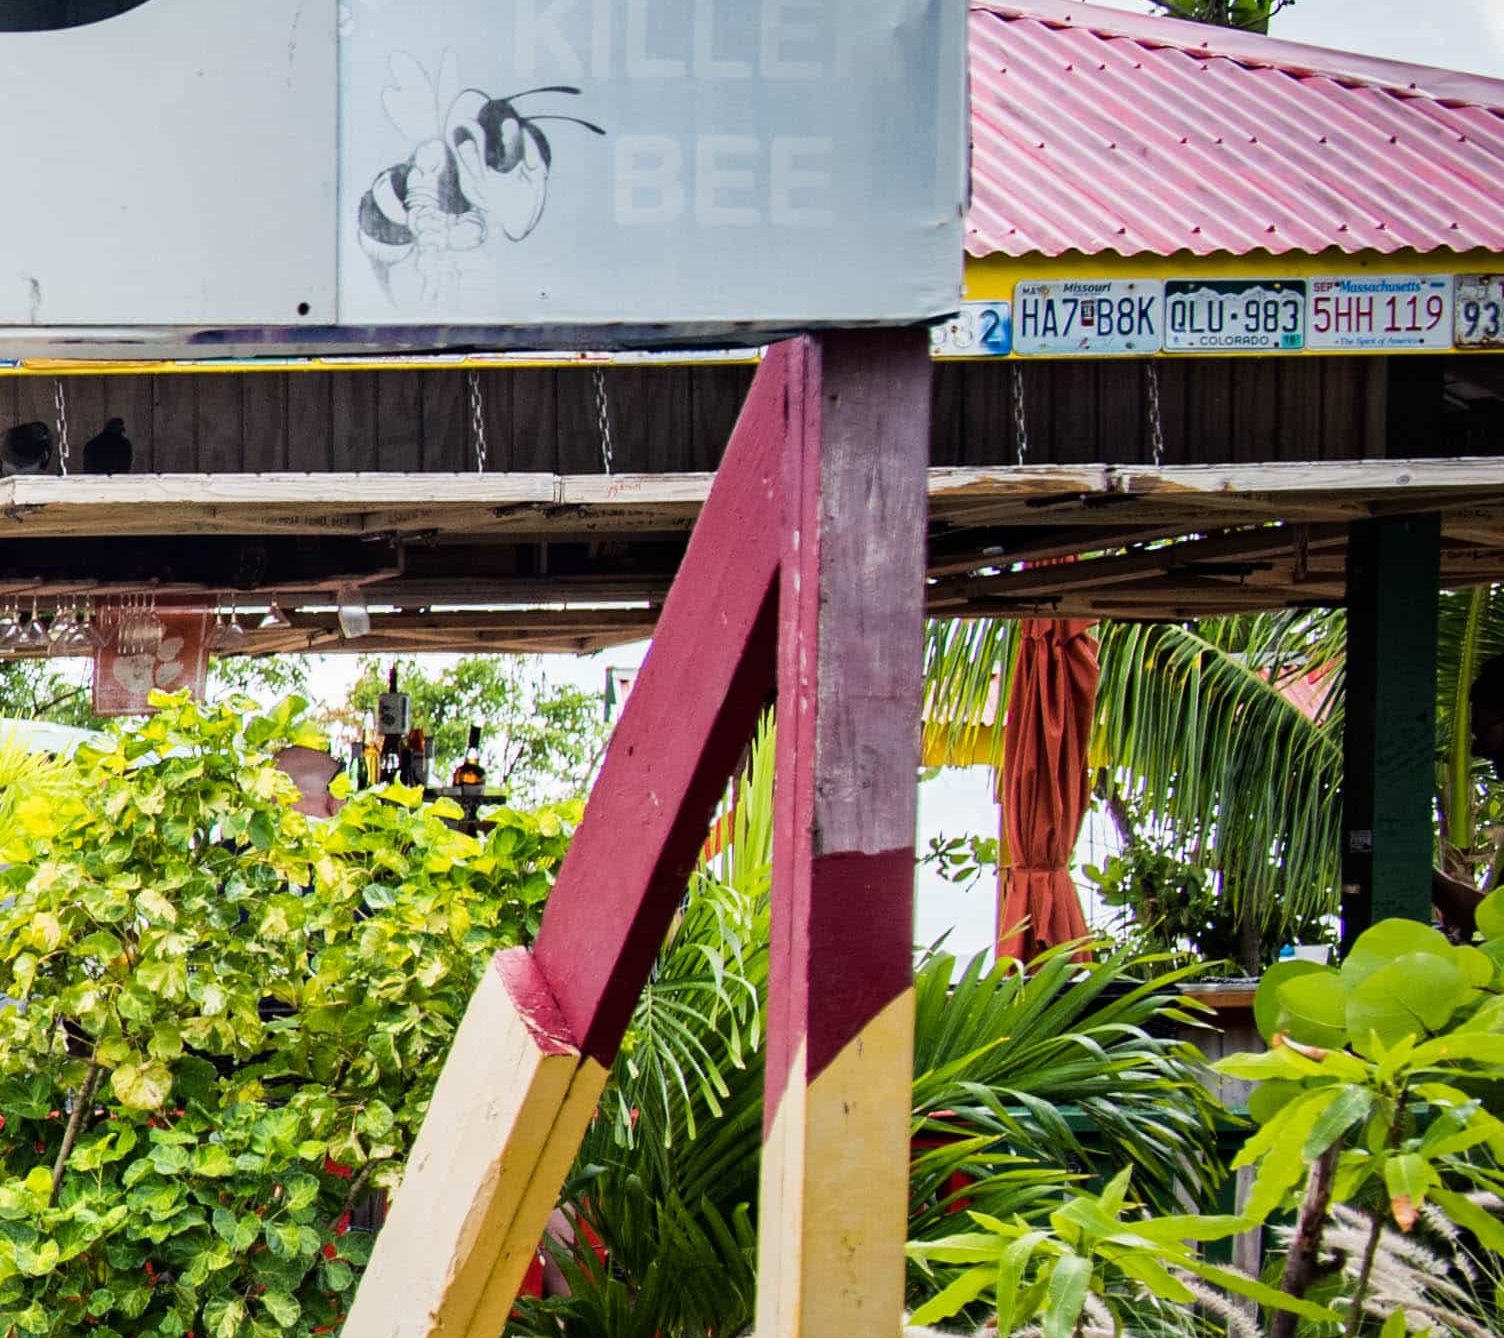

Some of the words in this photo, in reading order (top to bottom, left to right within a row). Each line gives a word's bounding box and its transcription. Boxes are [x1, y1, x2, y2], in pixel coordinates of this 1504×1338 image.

[614, 134, 834, 227] BEE
[1063, 282, 1112, 293] Missouri
[1313, 281, 1333, 292] SEP
[1339, 279, 1421, 293] Massachusetts
[1313, 296, 1373, 333] 5HH
[1384, 294, 1443, 331] 119
[1199, 335, 1270, 346] COLORADO
